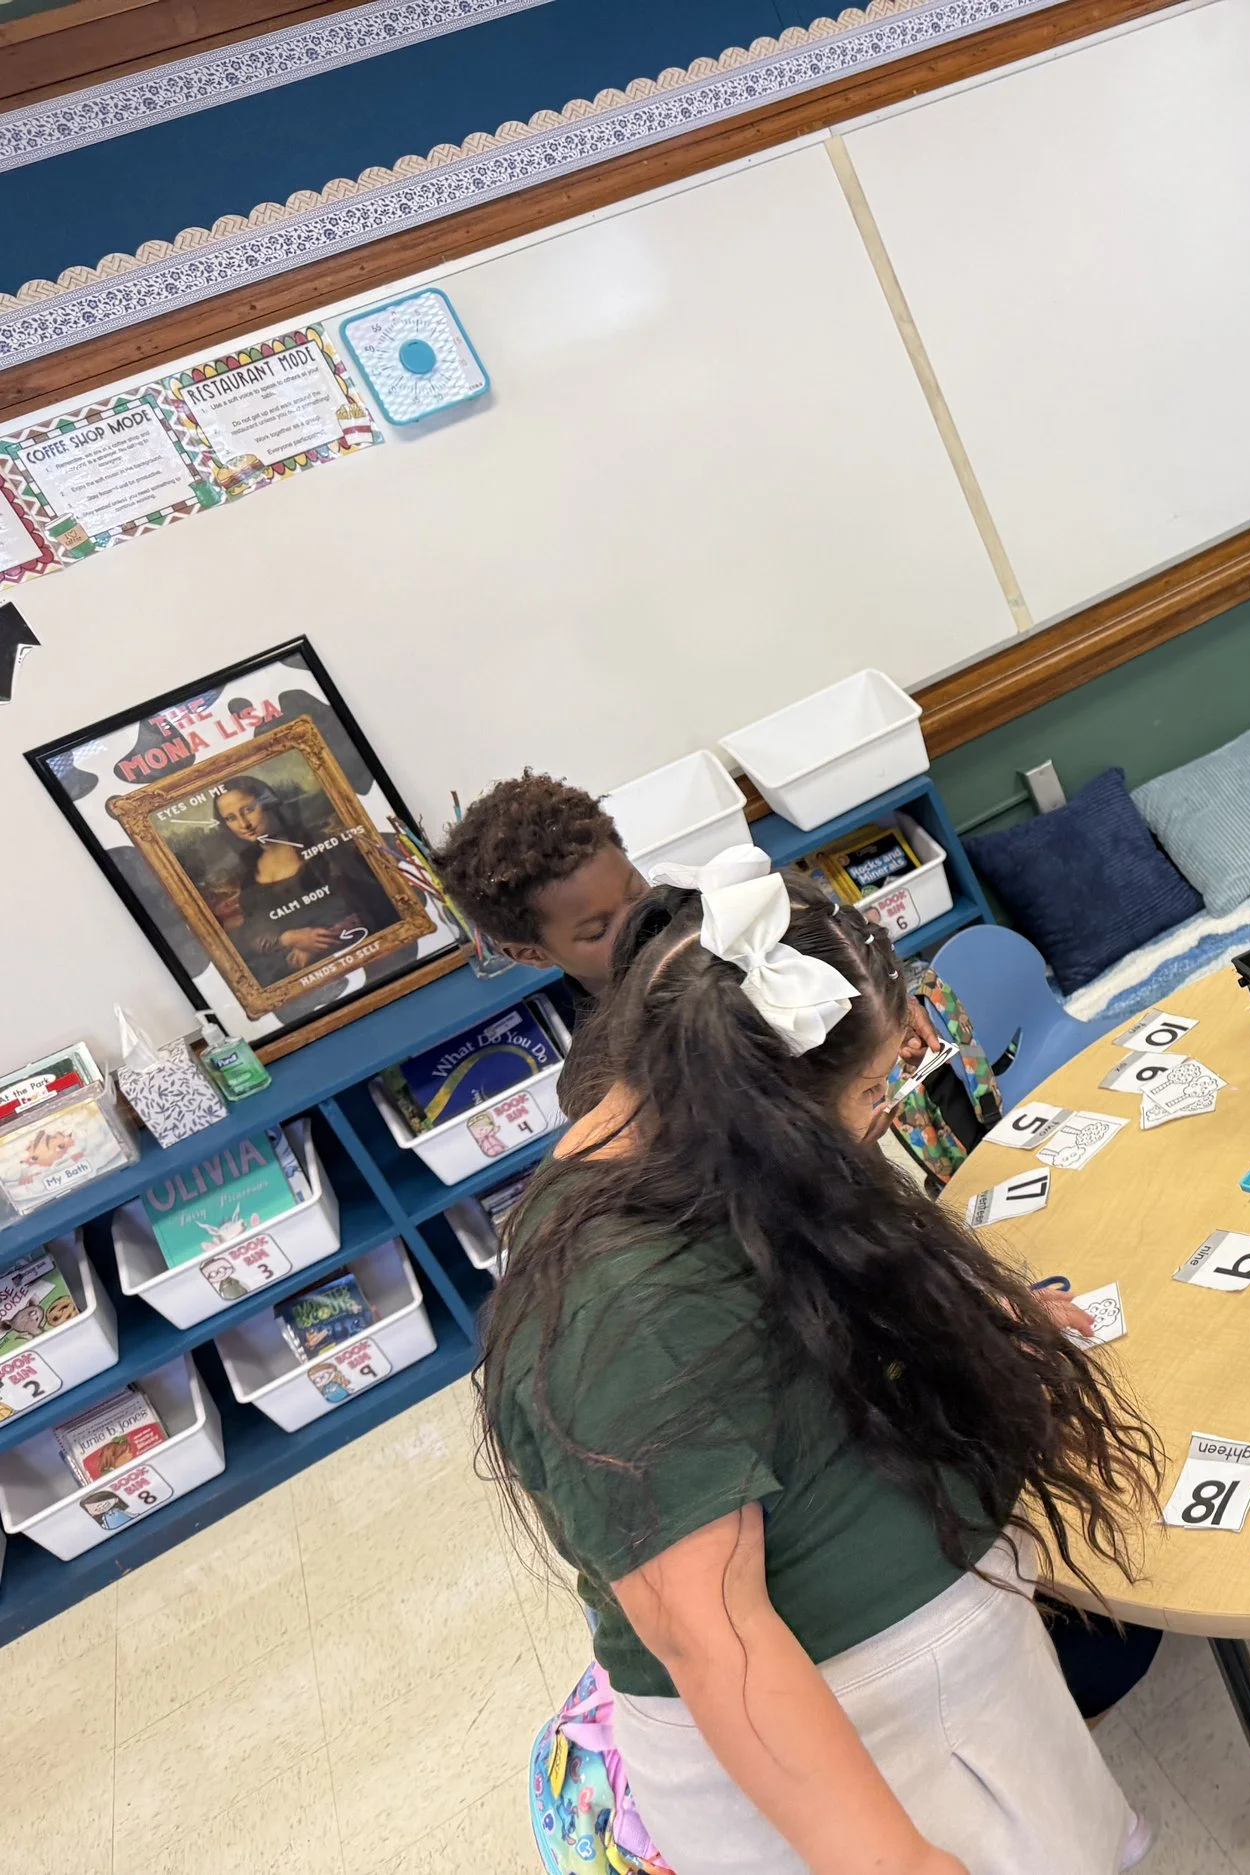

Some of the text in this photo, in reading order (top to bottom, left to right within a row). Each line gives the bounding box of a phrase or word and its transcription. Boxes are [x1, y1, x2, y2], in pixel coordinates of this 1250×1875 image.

[186, 345, 316, 405] RESTAURANT MODE
[24, 439, 70, 465] COFFEE
[69, 425, 107, 448] SHOP
[106, 408, 152, 434] MODE
[148, 697, 213, 737] THE
[118, 698, 284, 782] MONA LISA
[156, 784, 228, 822] EYES ON ME
[300, 824, 367, 861] ZIPPED LIPS
[850, 859, 883, 878] Rocks
[883, 846, 903, 862] and
[859, 858, 906, 885] Minerals
[269, 885, 332, 920] CALM BODY
[878, 890, 908, 911] BOOK
[886, 901, 906, 918] BIN
[896, 915, 908, 931] 6
[300, 940, 382, 988] HANDS TO SELF
[1144, 1022, 1190, 1048] 10
[432, 1041, 476, 1079] What
[506, 1030, 532, 1049] You
[531, 1043, 548, 1064] Do
[1135, 1066, 1170, 1082] 6
[13, 1089, 28, 1098] the
[30, 1077, 49, 1090] Park
[494, 1094, 530, 1118] BOOK
[505, 1106, 530, 1123] BIN
[517, 1121, 534, 1134] 4
[45, 1162, 89, 1188] My Bath
[146, 1138, 268, 1212] OLIVIA
[1005, 1174, 1049, 1202] 17
[228, 1236, 270, 1261] BOOK
[243, 1248, 270, 1266] BIN
[1190, 1244, 1212, 1266] nine
[257, 1264, 274, 1280] 3
[334, 1340, 372, 1365] BOOK
[346, 1352, 372, 1369] BIN
[8, 1366, 38, 1385] BIN
[360, 1364, 378, 1378] 9
[22, 1380, 46, 1399] 2
[80, 1432, 106, 1455] junie
[118, 1409, 148, 1434] jones
[110, 1466, 150, 1492] BOOK
[124, 1478, 152, 1496] BIN
[138, 1490, 158, 1506] 8
[1180, 1479, 1242, 1526] 18
